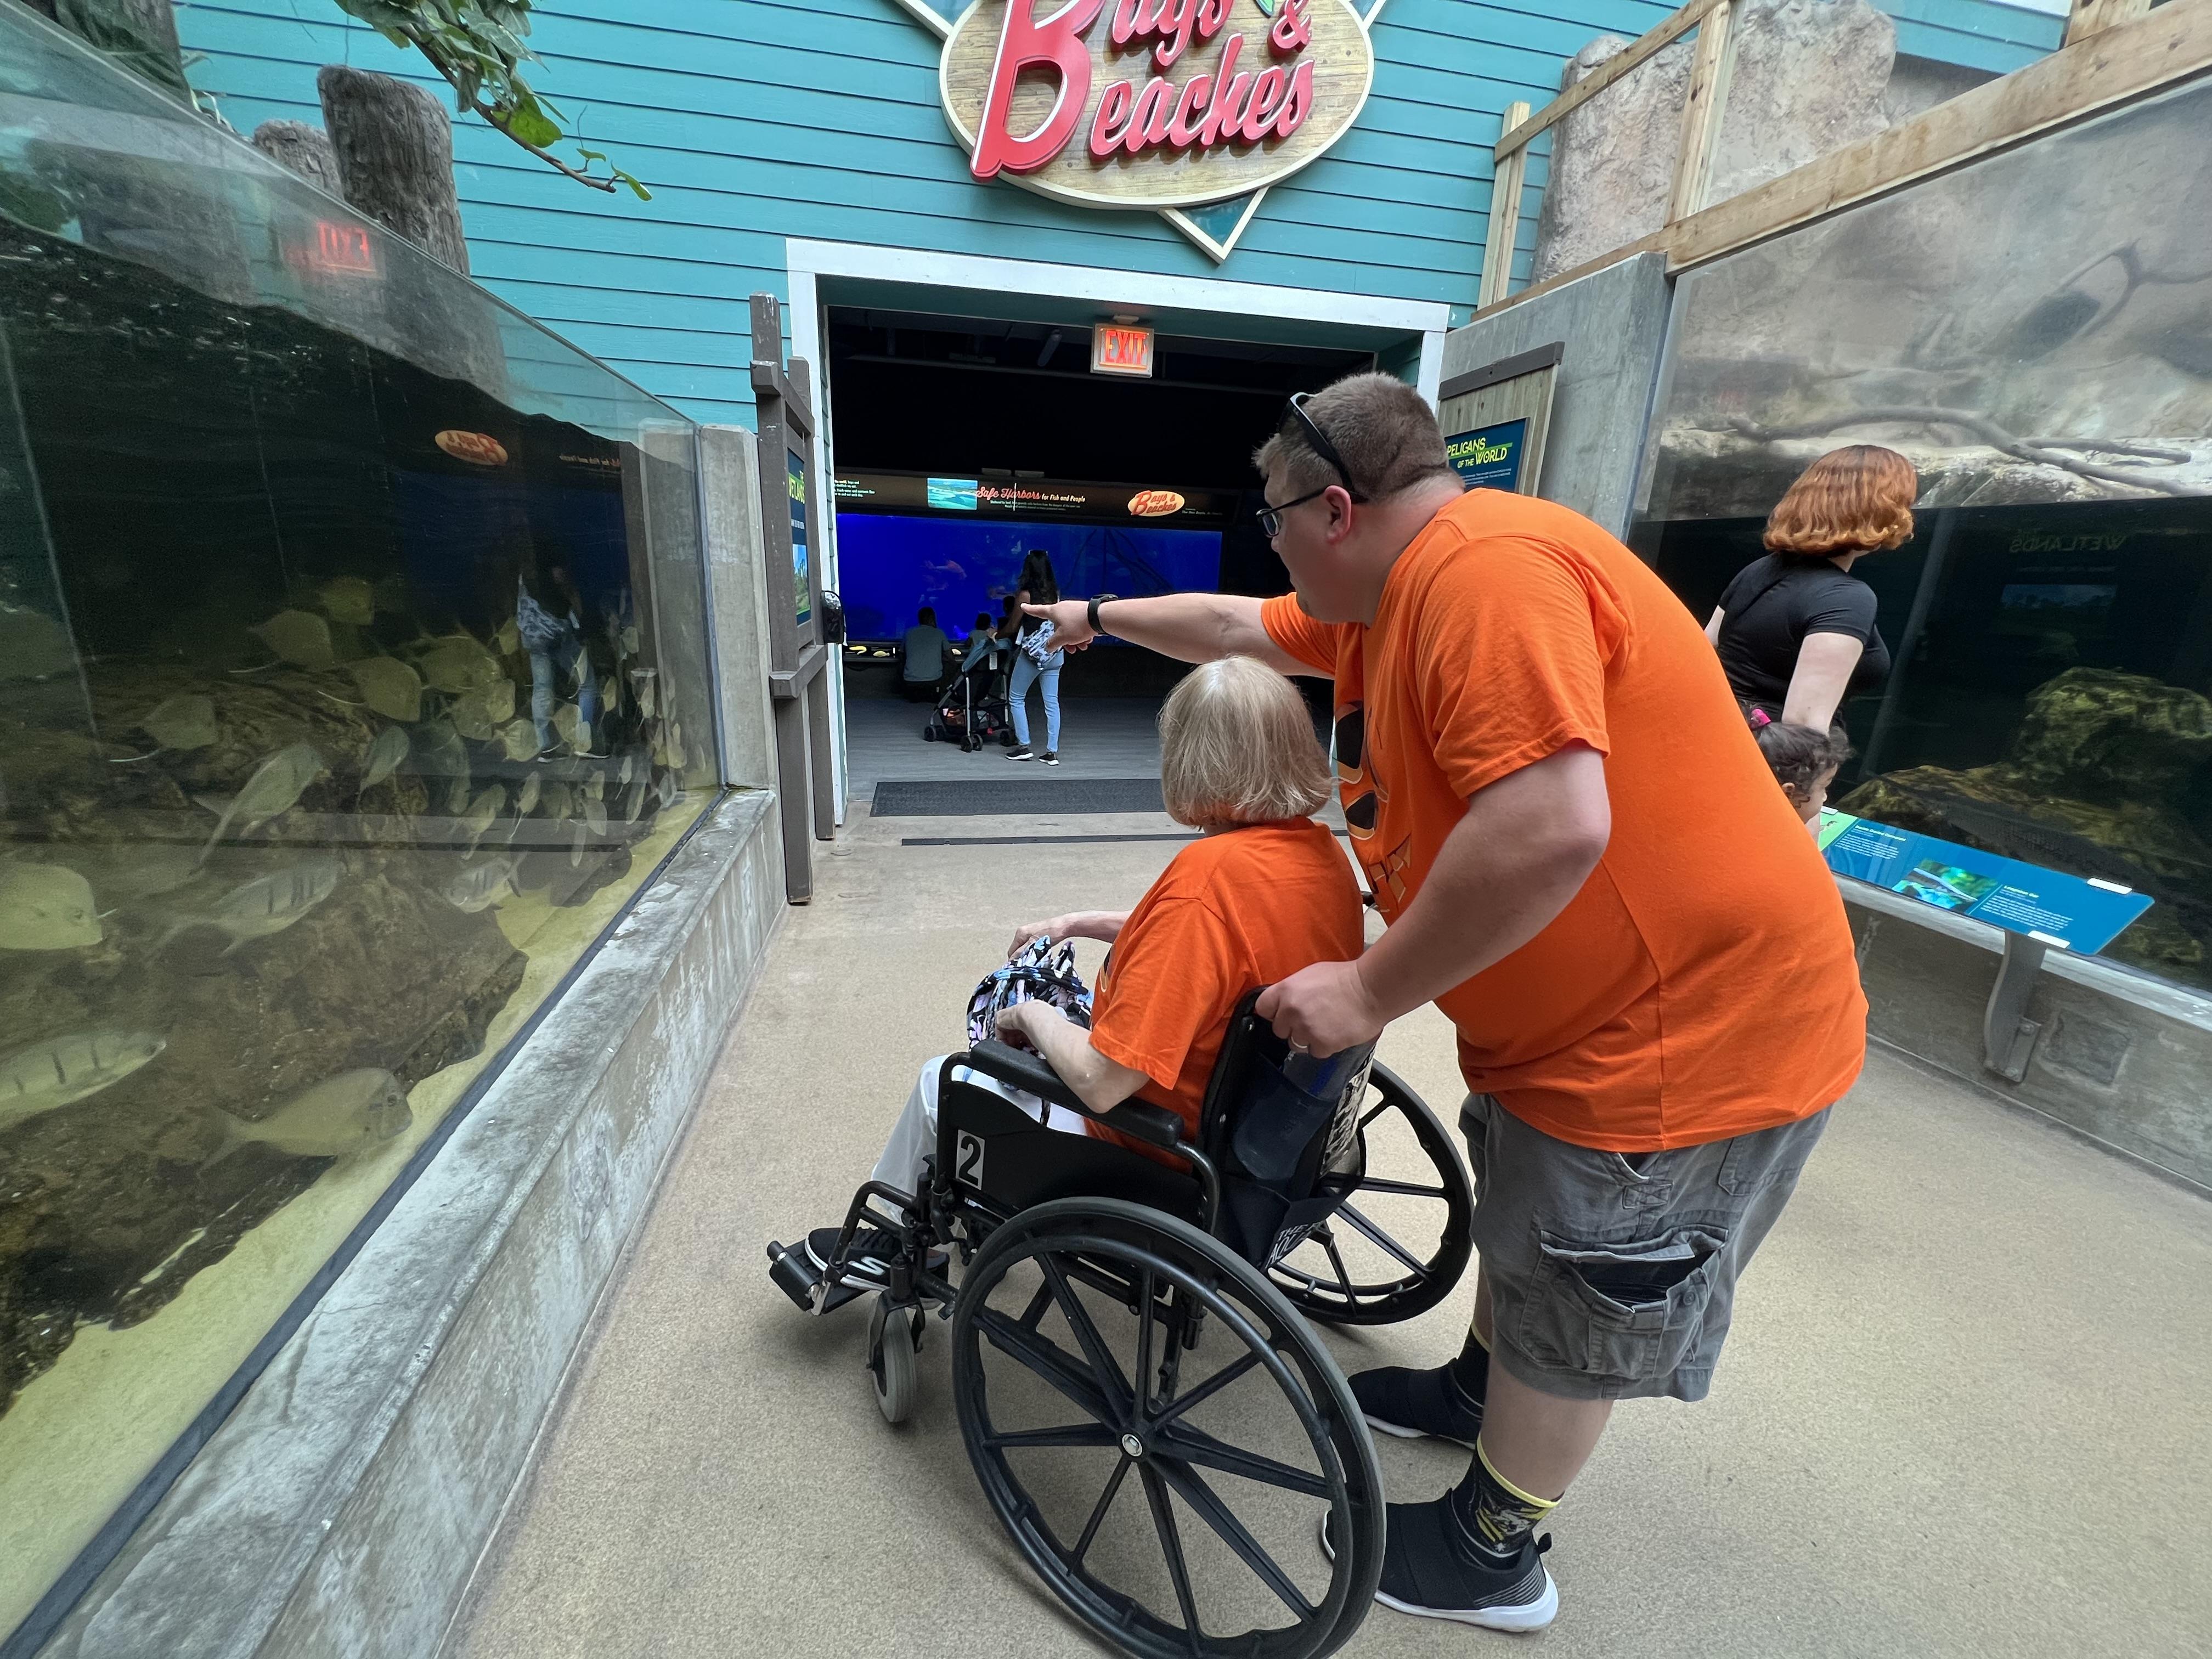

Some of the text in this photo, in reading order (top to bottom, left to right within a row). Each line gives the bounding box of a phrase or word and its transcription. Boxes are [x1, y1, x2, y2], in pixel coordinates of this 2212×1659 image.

[1104, 330, 1146, 365] EXIT
[1447, 437, 1486, 456] PELICANS
[1457, 447, 1507, 469] OF THE WORLD
[977, 486, 999, 500] Safe
[1001, 488, 1041, 500] Harbors
[959, 1135, 981, 1186] 2
